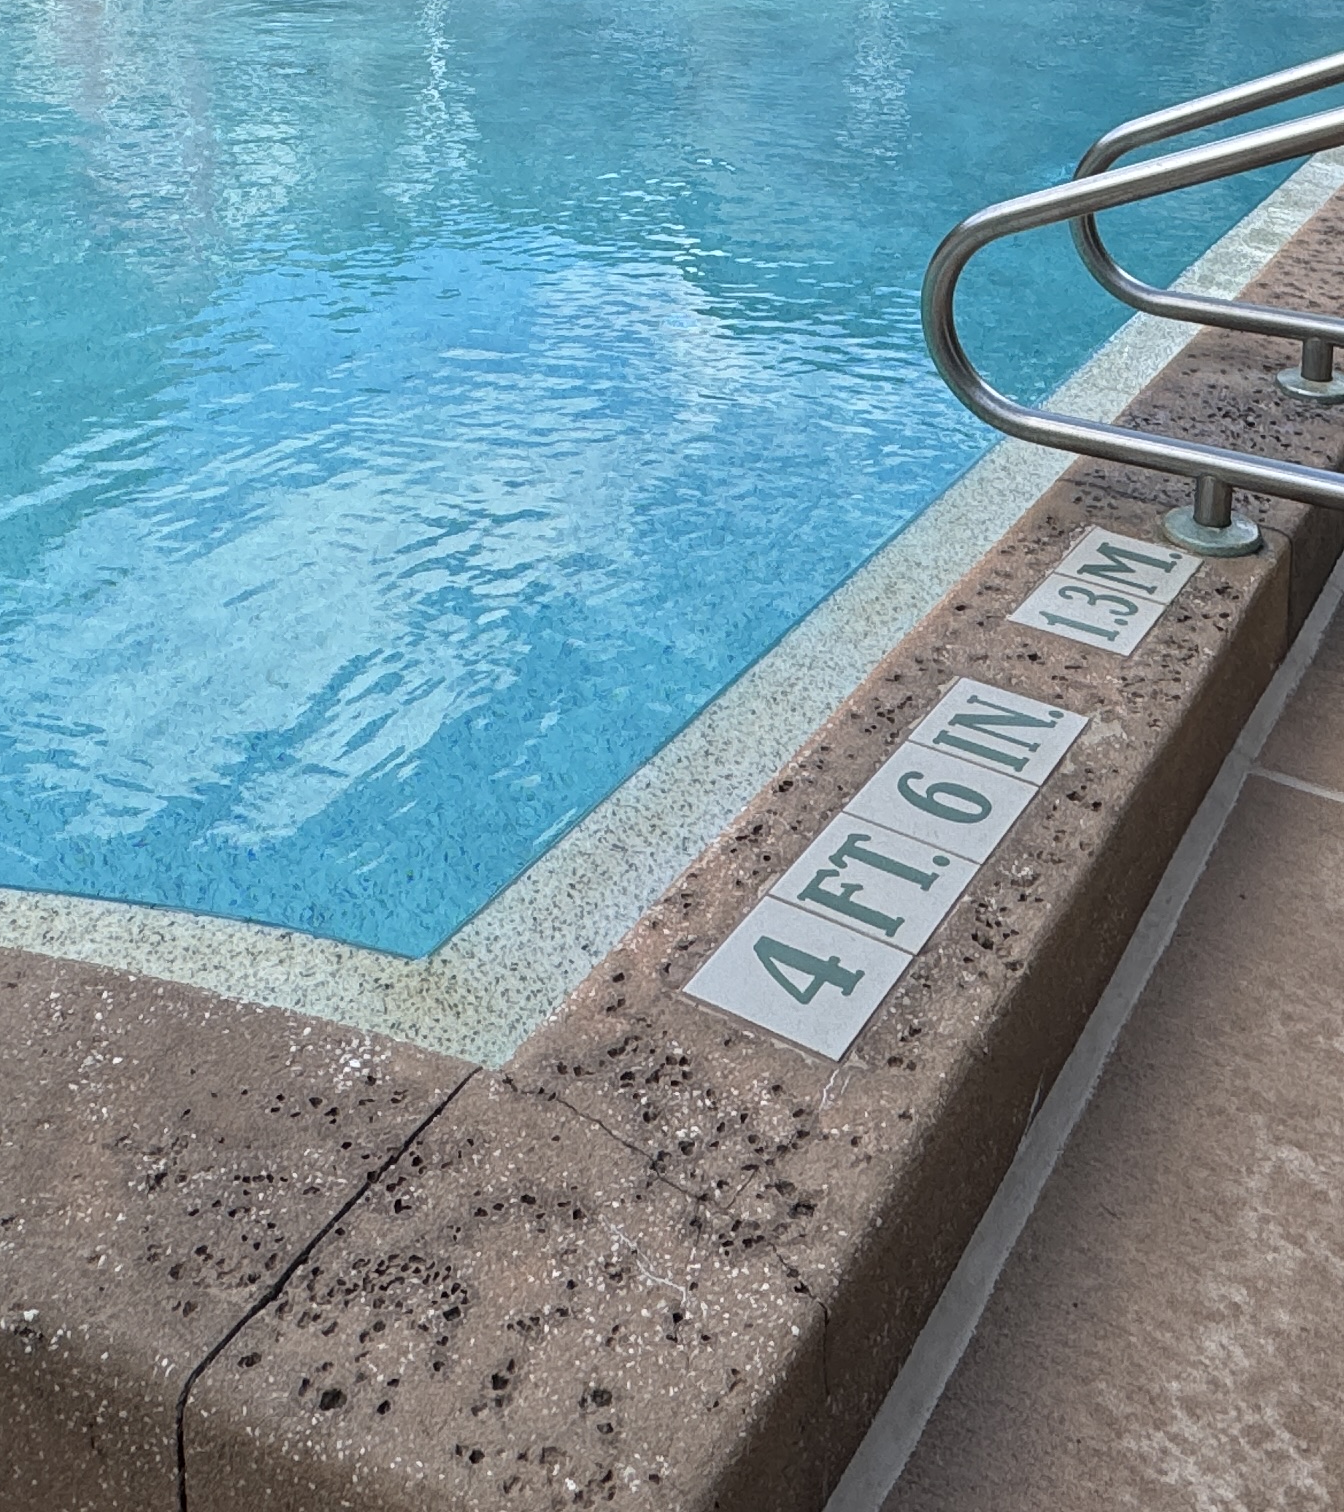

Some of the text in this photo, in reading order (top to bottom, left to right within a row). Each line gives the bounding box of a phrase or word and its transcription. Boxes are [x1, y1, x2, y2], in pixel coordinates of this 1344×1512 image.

[753, 694, 1065, 1006] 4 FT. 6 IN.
